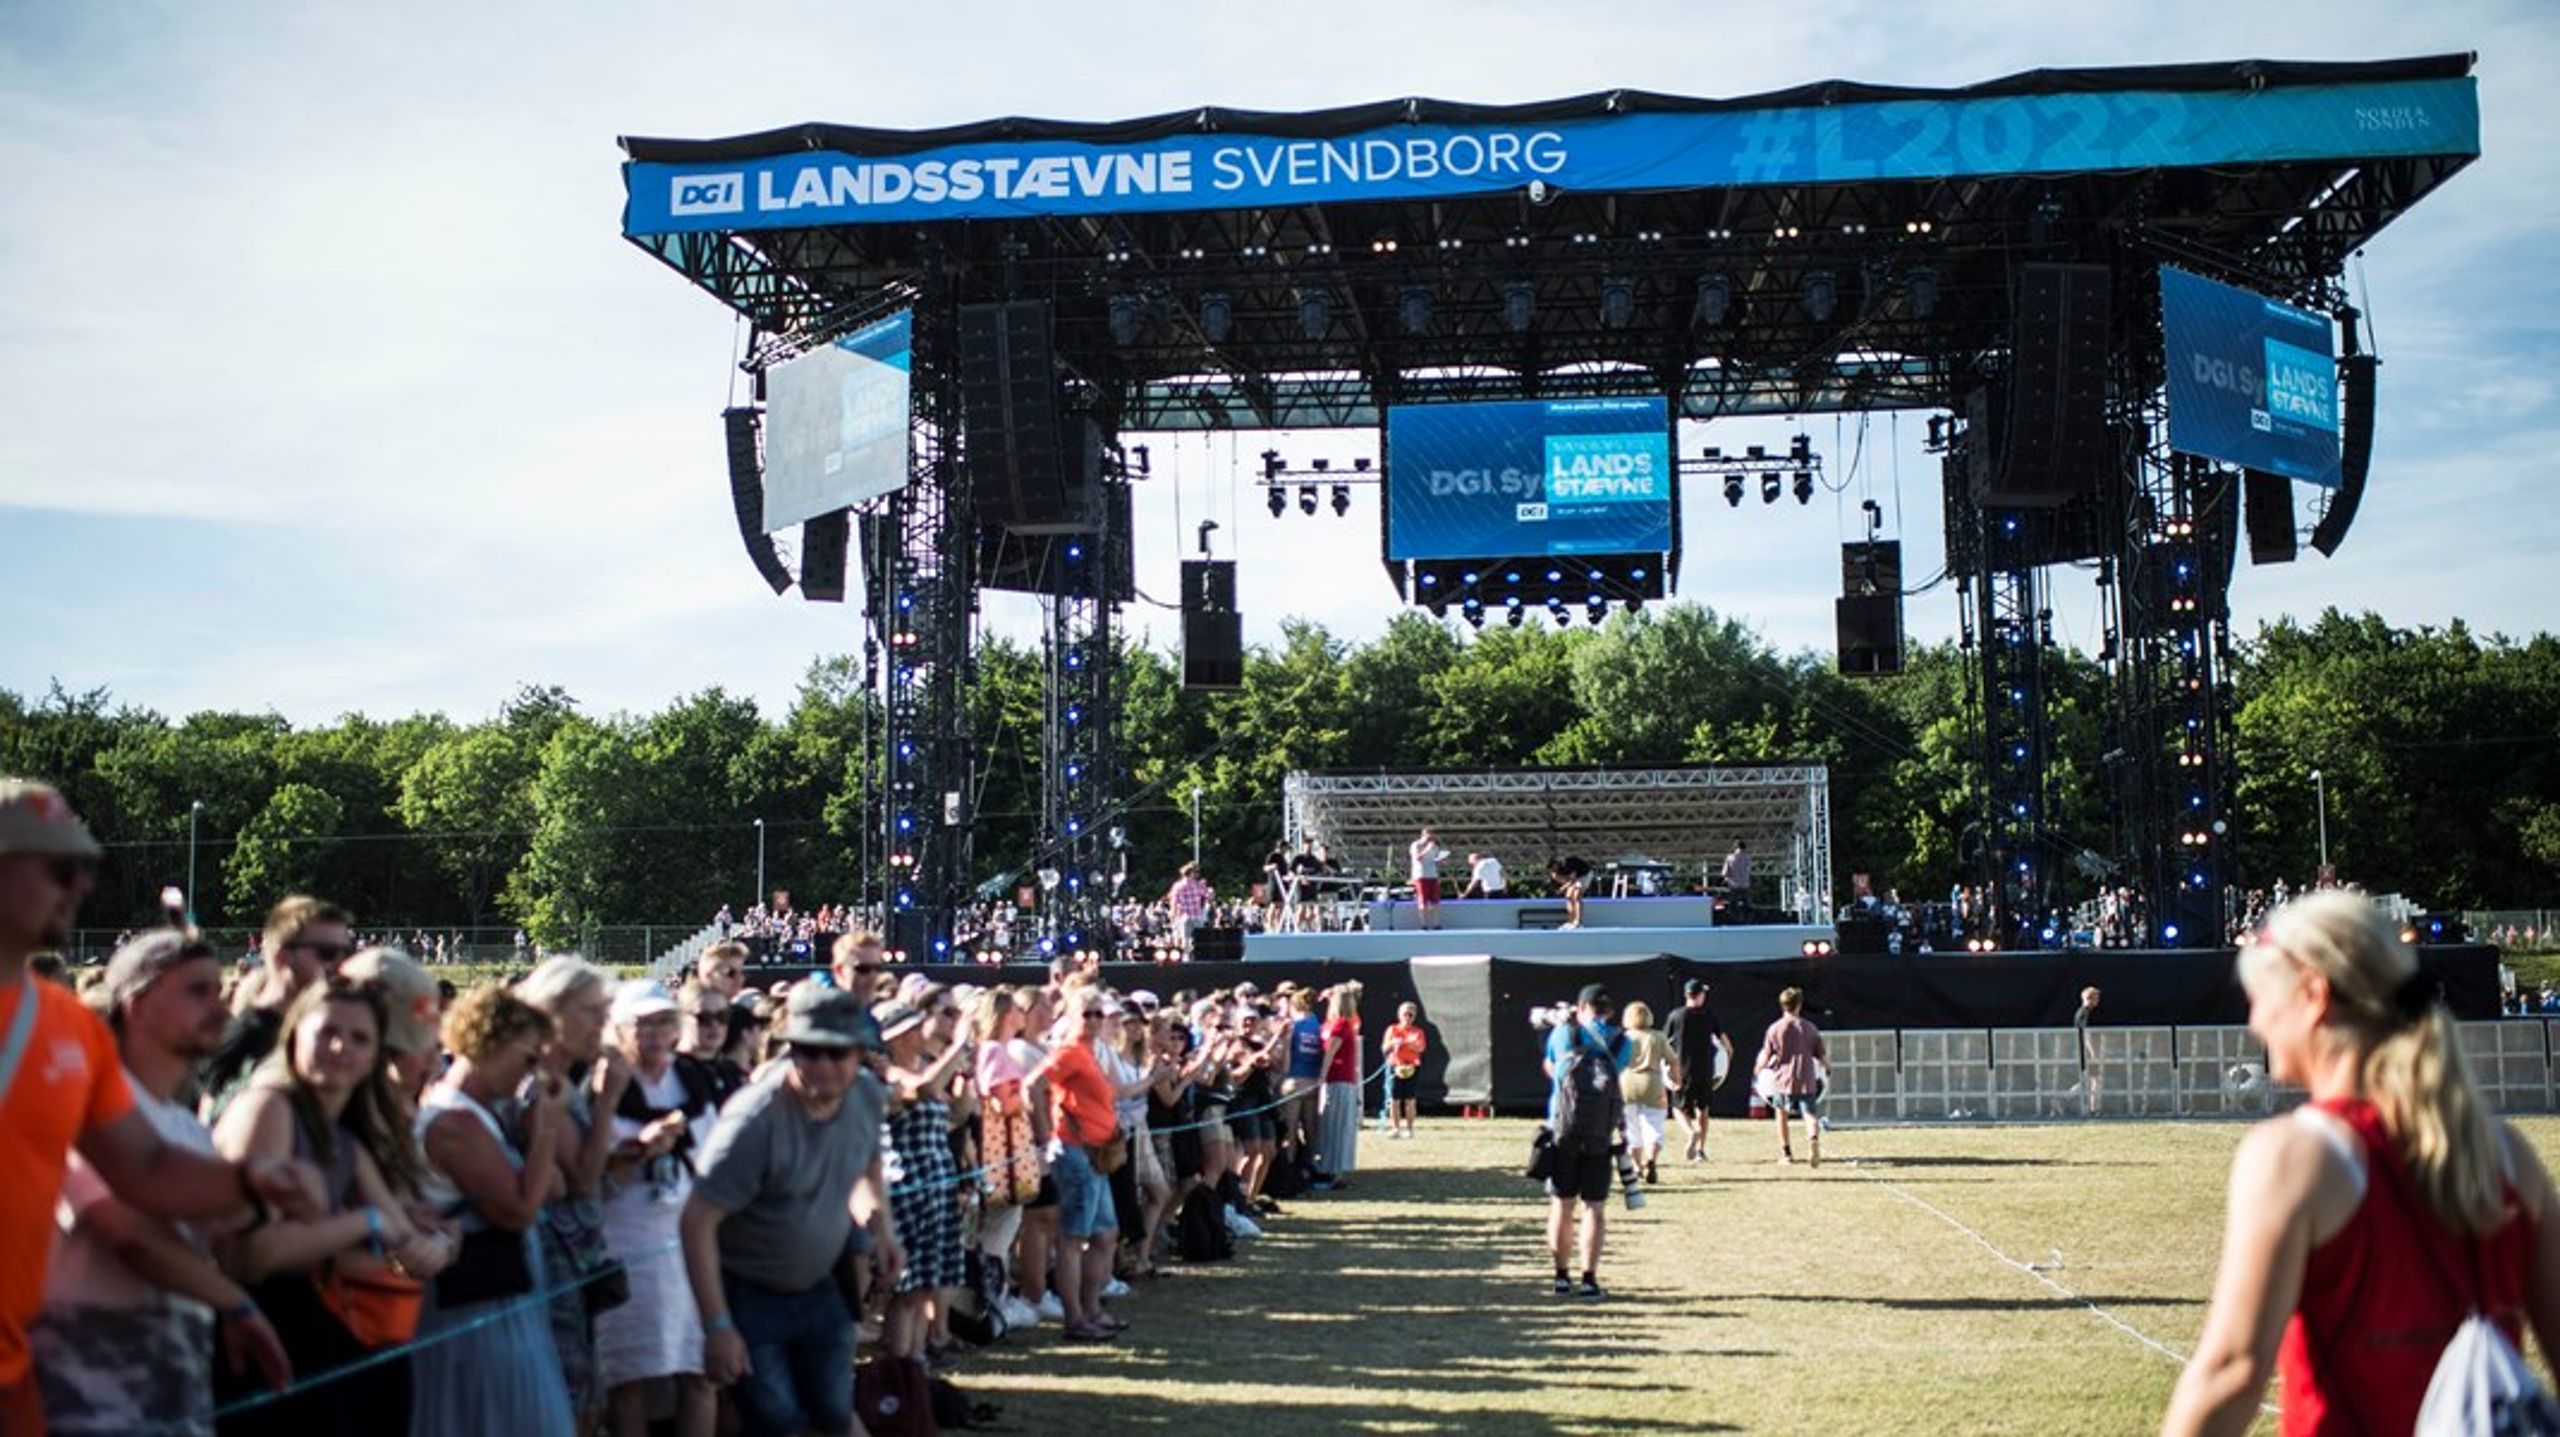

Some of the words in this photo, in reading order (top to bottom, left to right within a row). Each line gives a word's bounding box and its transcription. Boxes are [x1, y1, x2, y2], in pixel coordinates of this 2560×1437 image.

[1731, 92, 2194, 183] #L2022
[680, 182, 734, 206] DGI
[759, 151, 1192, 211] LANDSSTÆVNE
[1213, 132, 1567, 190] SVENDBORG
[2271, 361, 2328, 400] LANDS
[1553, 453, 1652, 477] LANDS
[1431, 468, 1492, 496] DGI
[1554, 476, 1654, 496] STÆVNE
